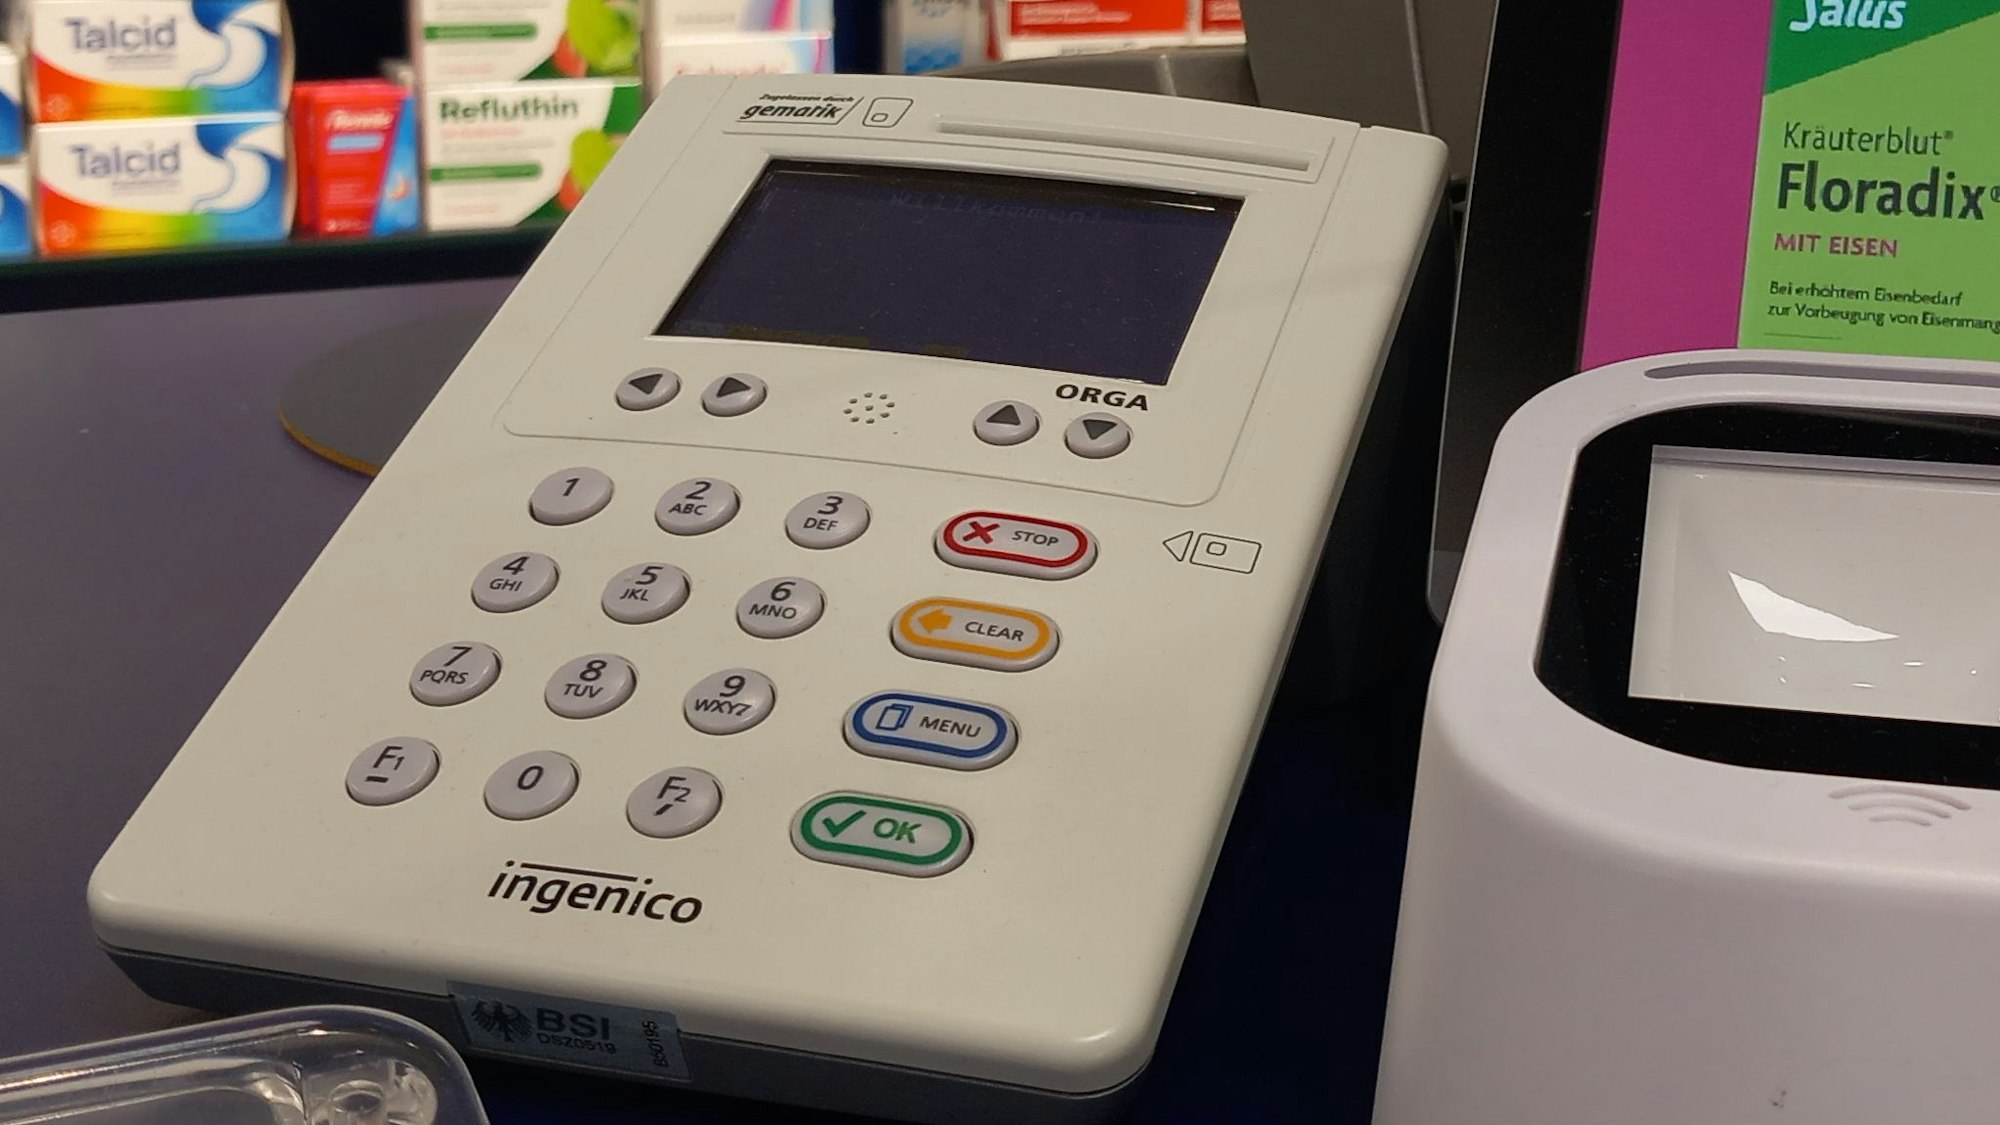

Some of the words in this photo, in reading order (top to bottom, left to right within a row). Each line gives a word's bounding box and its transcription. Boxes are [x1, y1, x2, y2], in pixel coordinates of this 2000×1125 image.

[64, 15, 178, 51] Talcid
[439, 94, 579, 120] Refluthin
[739, 103, 843, 120] gematik
[71, 143, 181, 177] Talcid
[1774, 233, 1821, 252] MIT
[1829, 236, 1899, 258] EISEN
[1769, 280, 1792, 295] Bei
[1795, 282, 1869, 300] erhöhtem
[1874, 287, 1963, 306] Eisenbedarf
[1768, 304, 1791, 316] zur
[1795, 303, 1885, 326] Vorbeugung
[1889, 313, 1918, 326] von
[1055, 383, 1149, 411] ORGA
[562, 478, 579, 497] 1
[685, 481, 711, 500] 2
[668, 503, 708, 516] ABC
[817, 496, 843, 515] 3
[803, 517, 838, 532] DEF
[1011, 529, 1060, 548] STOP
[502, 556, 529, 576] 4
[635, 566, 663, 585] 5
[489, 578, 523, 592] GHI
[619, 588, 649, 601] JKL
[770, 581, 797, 602] 6
[749, 604, 797, 620] MNO
[964, 620, 1025, 643] CLEAR
[443, 646, 471, 667] 7
[420, 669, 469, 685] PQRS
[579, 660, 607, 682] 8
[563, 683, 604, 699] TUV
[719, 675, 746, 697] 9
[918, 716, 982, 738] MENU
[373, 745, 405, 771] F1
[517, 765, 544, 790] 0
[658, 775, 691, 802] F2
[872, 817, 923, 844] OK
[488, 860, 703, 923] ingenico
[535, 1007, 610, 1040] BSI
